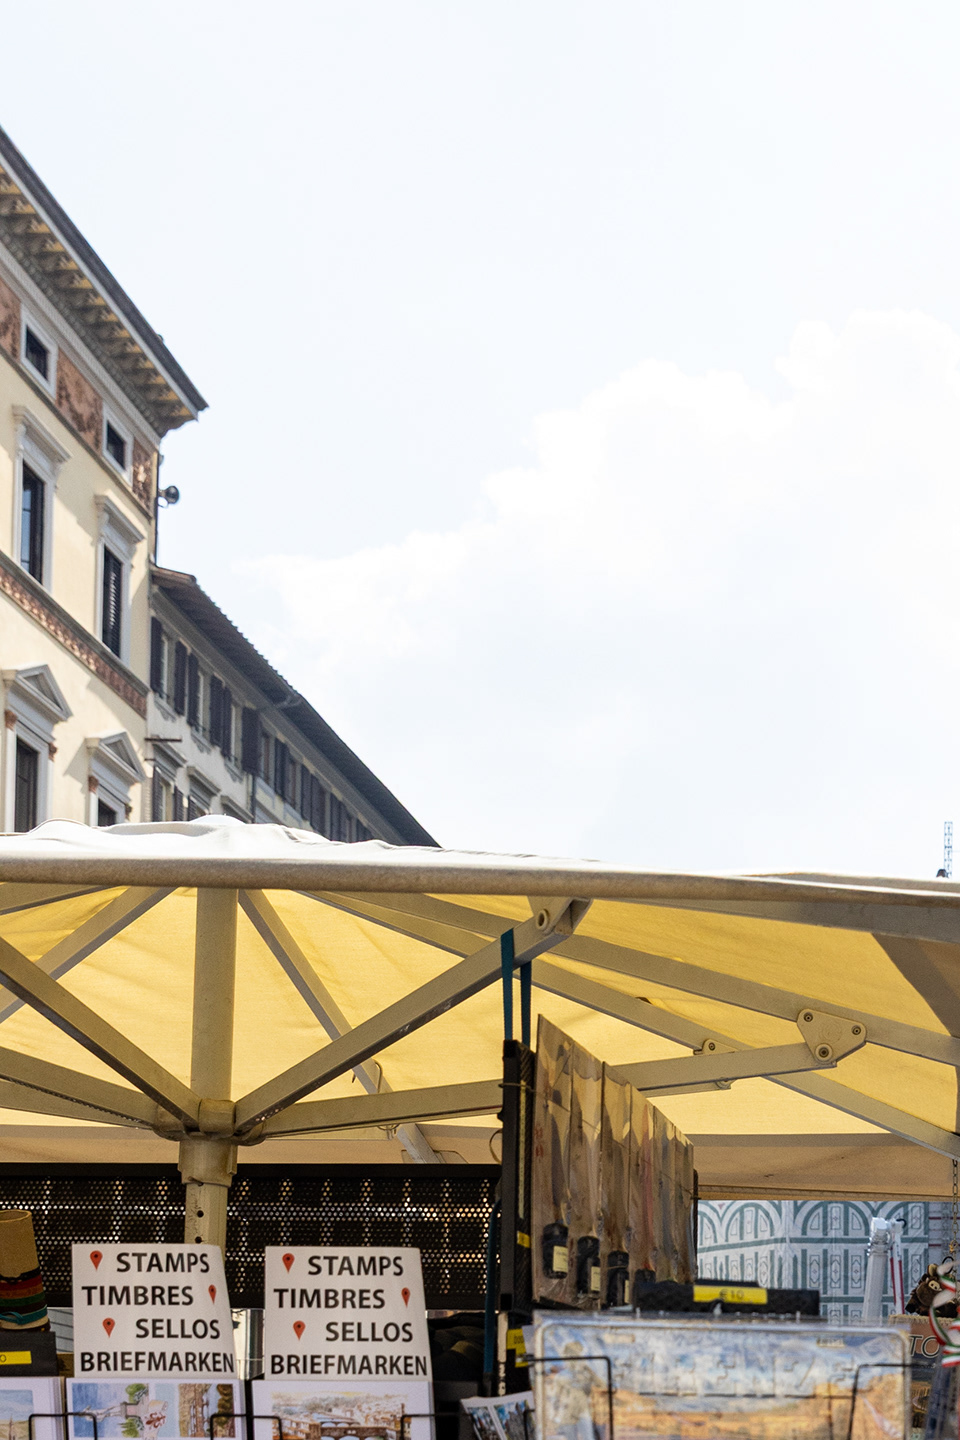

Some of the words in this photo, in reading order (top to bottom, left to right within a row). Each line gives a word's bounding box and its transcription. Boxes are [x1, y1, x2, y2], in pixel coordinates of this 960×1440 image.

[116, 1252, 210, 1273] STAMPS
[307, 1256, 404, 1276] STAMPS
[82, 1286, 194, 1306] TIMBRES
[274, 1289, 385, 1309] TIMBRES
[136, 1319, 220, 1339] SELLOS
[325, 1322, 413, 1342] SELLOS
[80, 1352, 235, 1373] BRIEFMARKEN
[271, 1354, 428, 1376] BRIEFMARKEN
